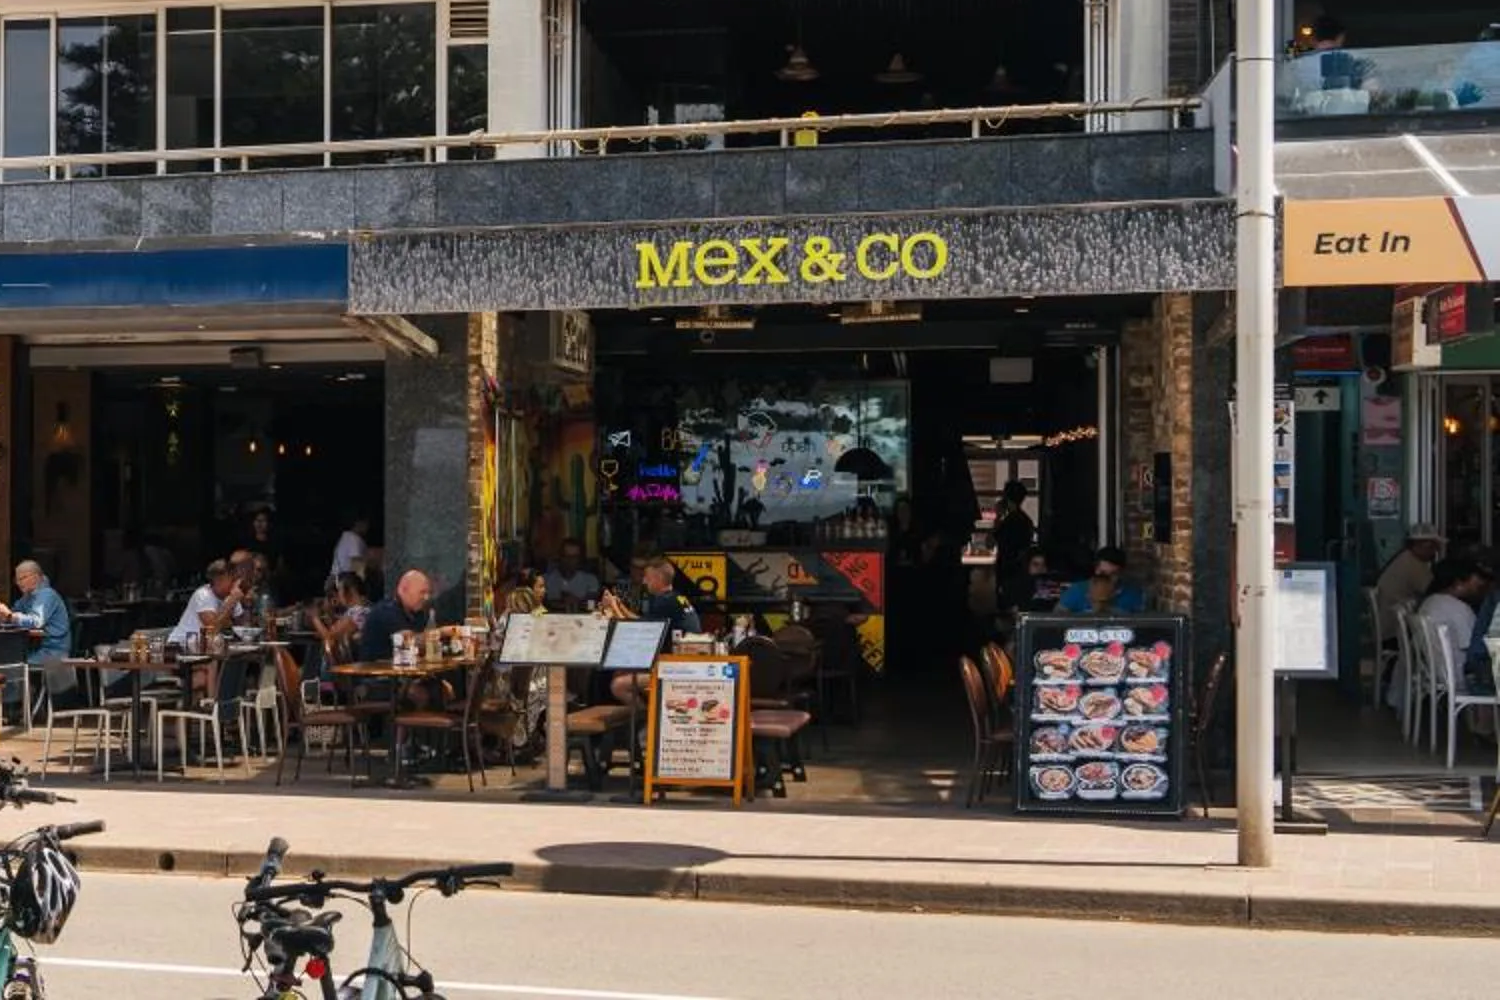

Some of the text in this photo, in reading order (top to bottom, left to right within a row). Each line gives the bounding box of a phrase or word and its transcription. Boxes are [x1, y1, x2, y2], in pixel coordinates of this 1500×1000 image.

[800, 235, 847, 282] &
[1313, 231, 1411, 255] Eat In
